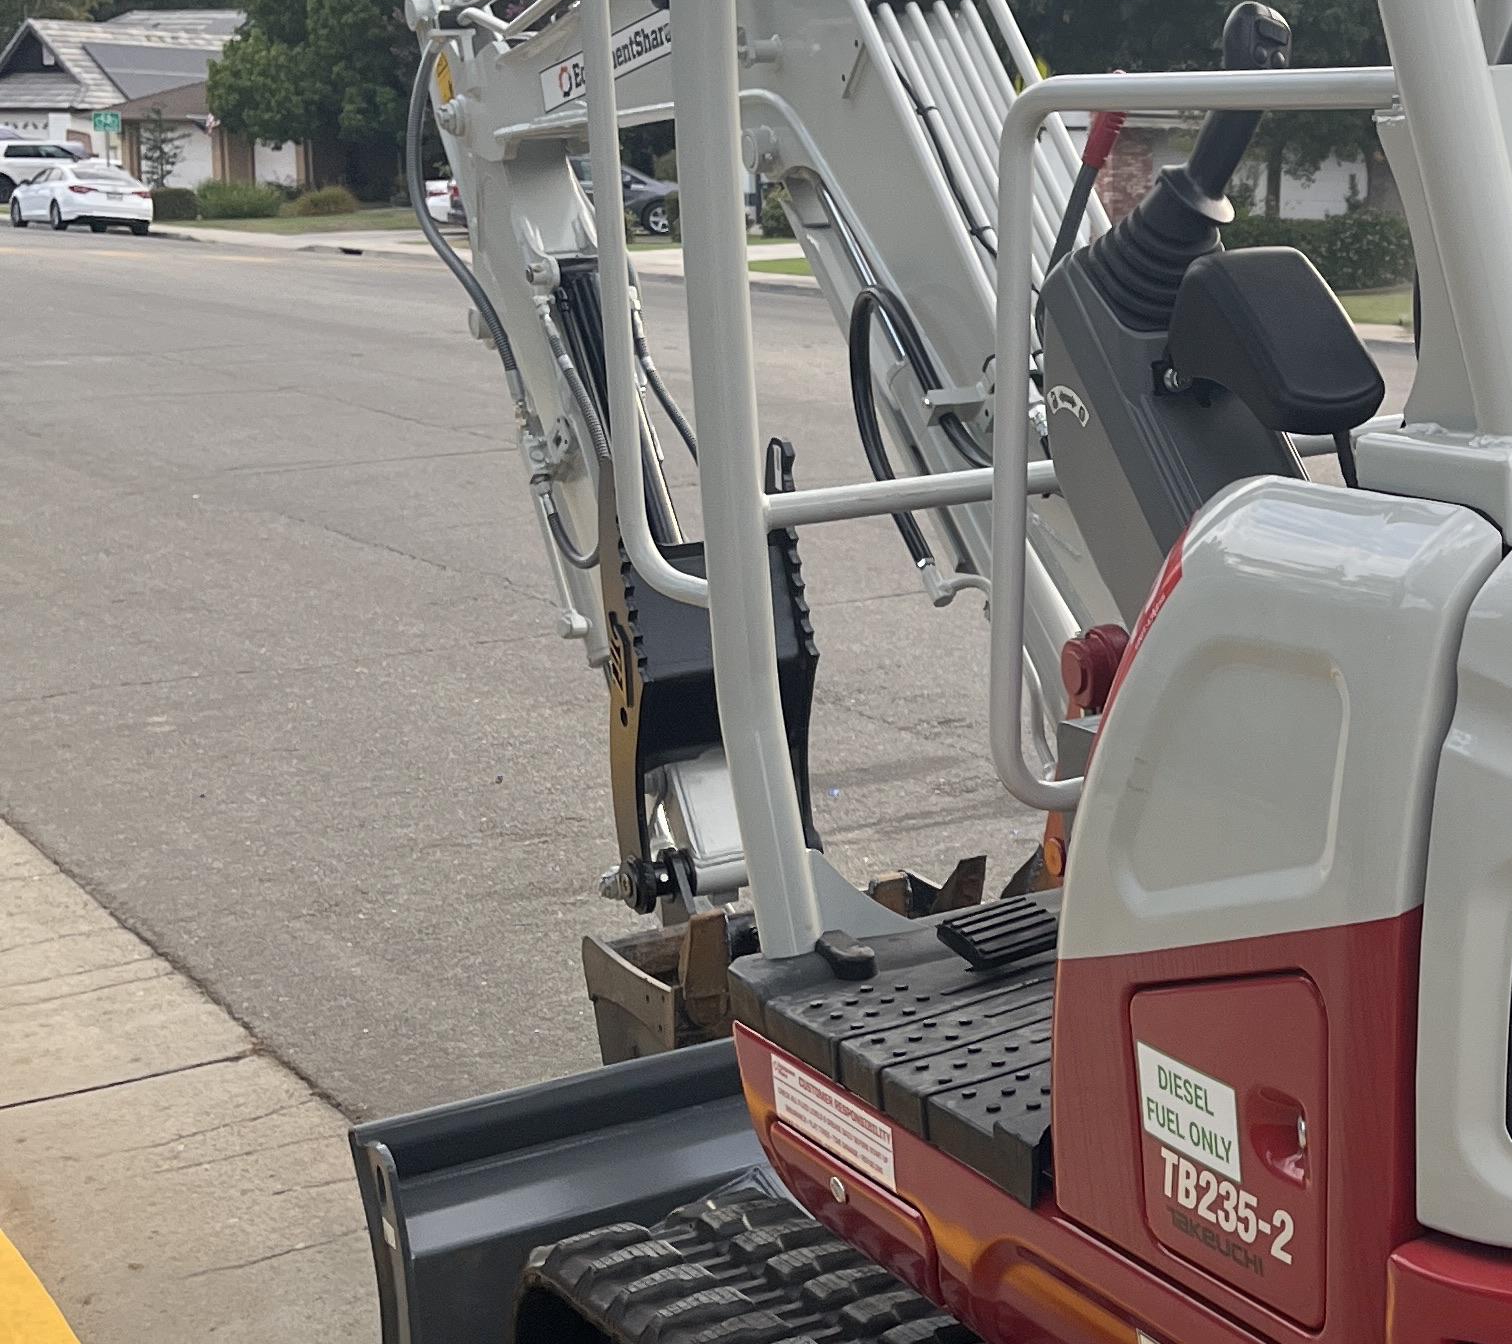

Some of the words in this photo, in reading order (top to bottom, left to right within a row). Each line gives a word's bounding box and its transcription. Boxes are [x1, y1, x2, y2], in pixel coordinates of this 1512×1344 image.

[1157, 1064, 1215, 1117] DIESEL
[1146, 1097, 1186, 1140] FUEL
[1189, 1121, 1232, 1164] ONLY
[1161, 1146, 1295, 1265] TB235-2
